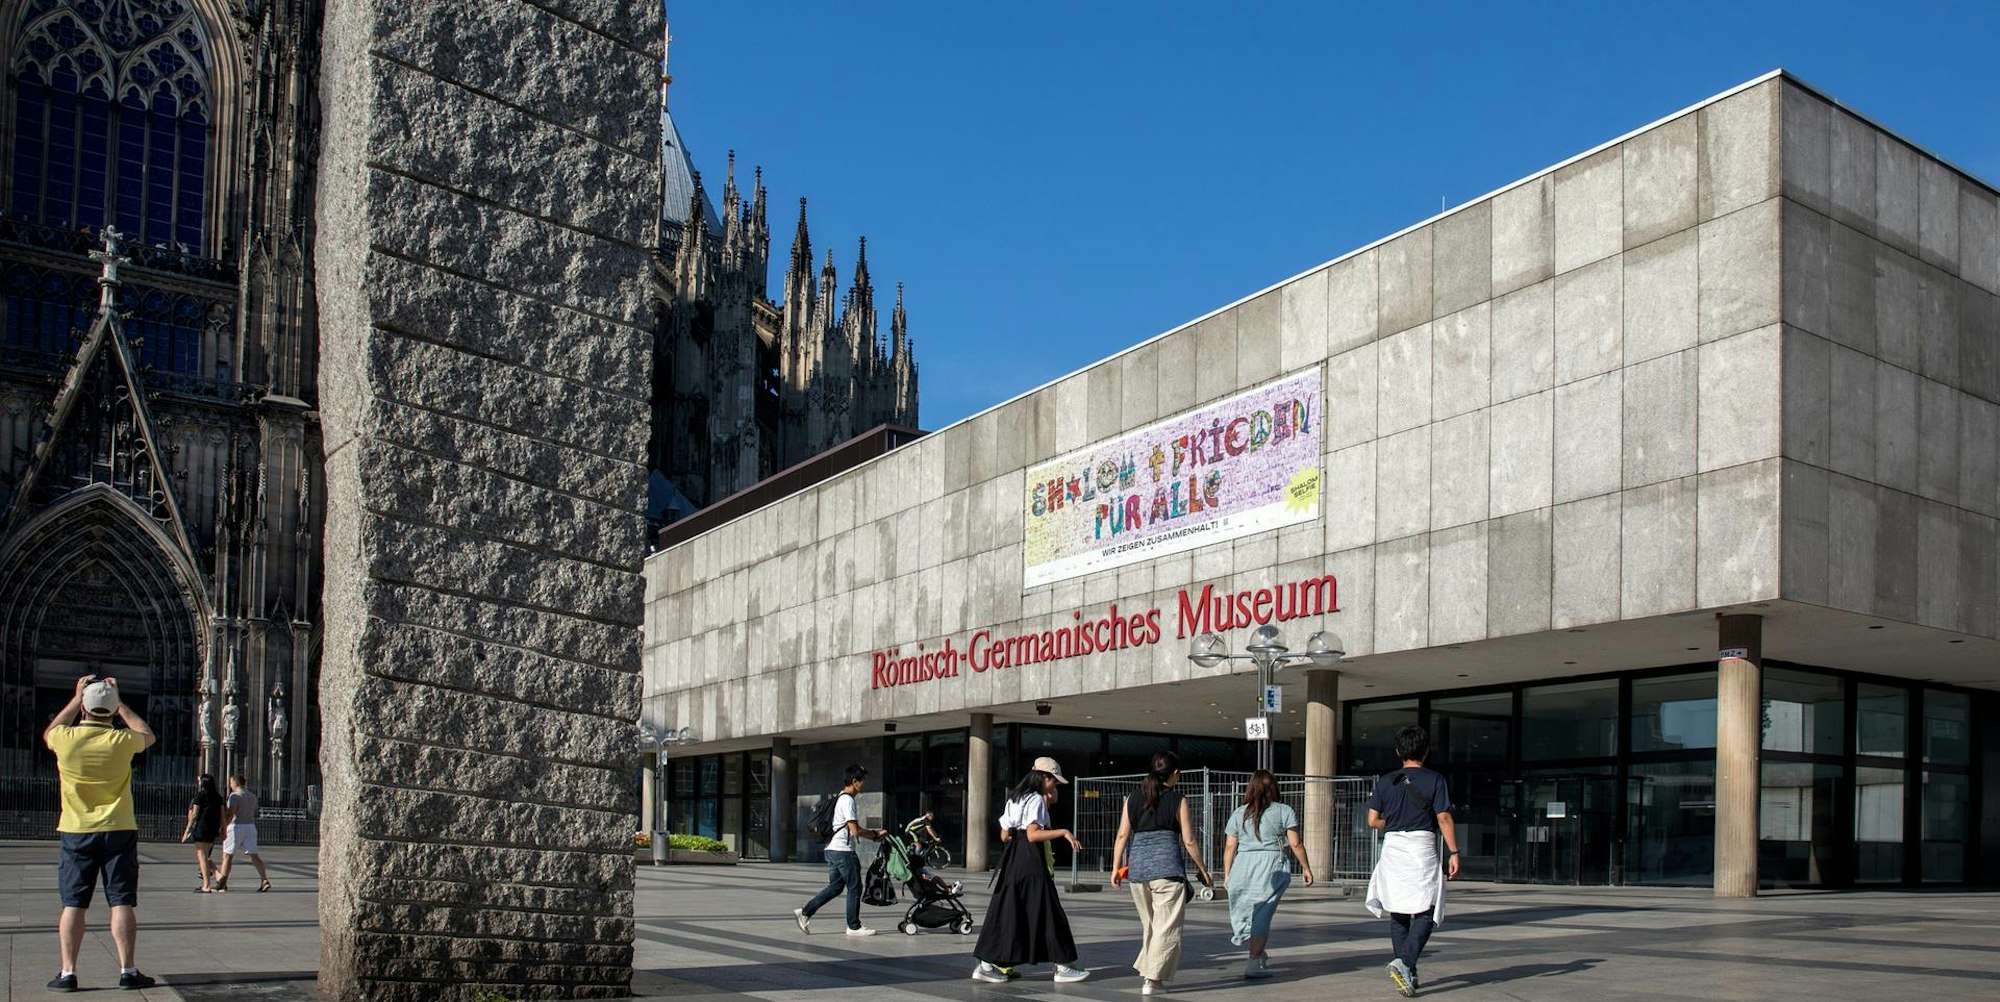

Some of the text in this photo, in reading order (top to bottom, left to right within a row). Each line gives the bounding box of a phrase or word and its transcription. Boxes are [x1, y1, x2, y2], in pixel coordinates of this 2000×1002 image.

[1290, 475, 1319, 494] SHALOM
[1293, 482, 1317, 499] SELFIE
[1095, 469, 1221, 540] FÜR ALLE
[1102, 520, 1220, 557] WIR ZEIGEN ZUSAMMENHALT!
[872, 574, 1339, 690] Römisch-Germanisches Museum
